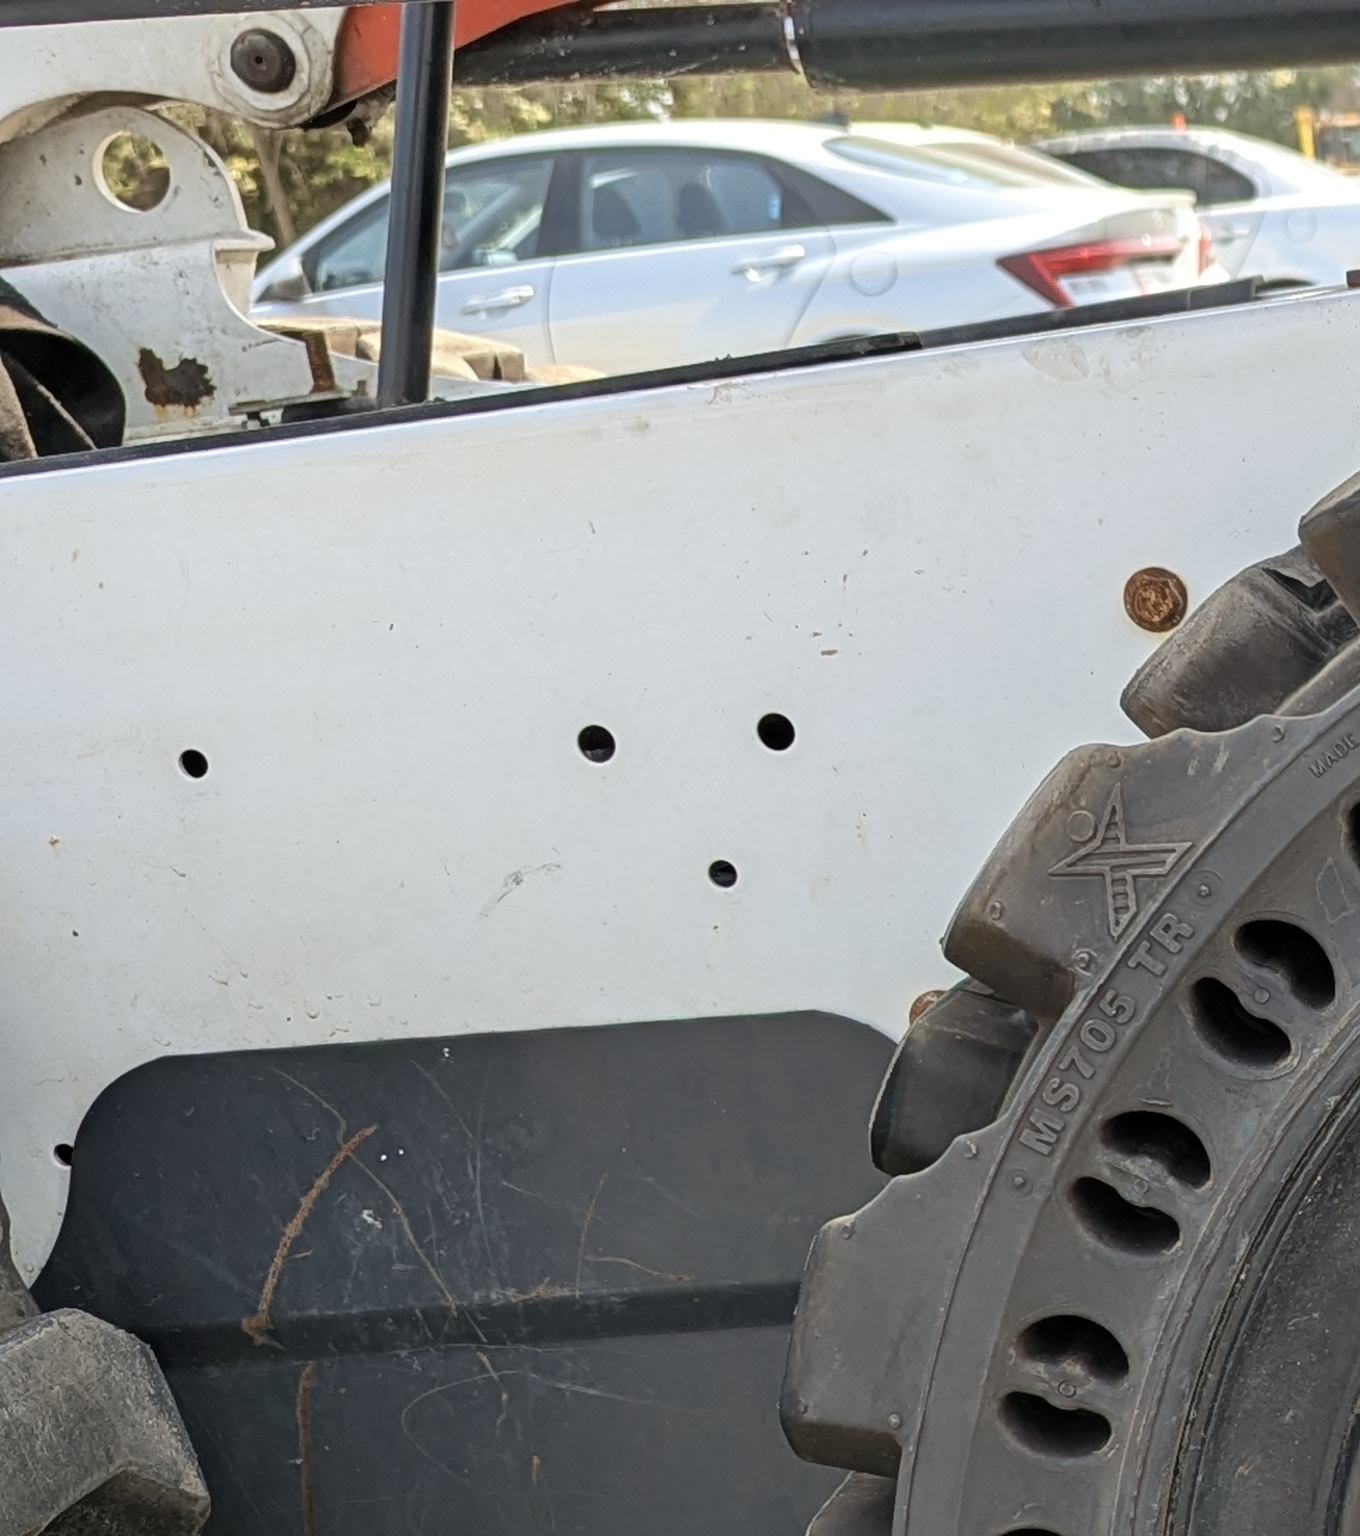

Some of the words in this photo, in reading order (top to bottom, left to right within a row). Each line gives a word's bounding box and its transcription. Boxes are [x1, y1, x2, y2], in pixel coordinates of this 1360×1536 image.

[1308, 733, 1360, 779] MADE
[1018, 988, 1138, 1157] MS705
[1128, 912, 1196, 979] TR
